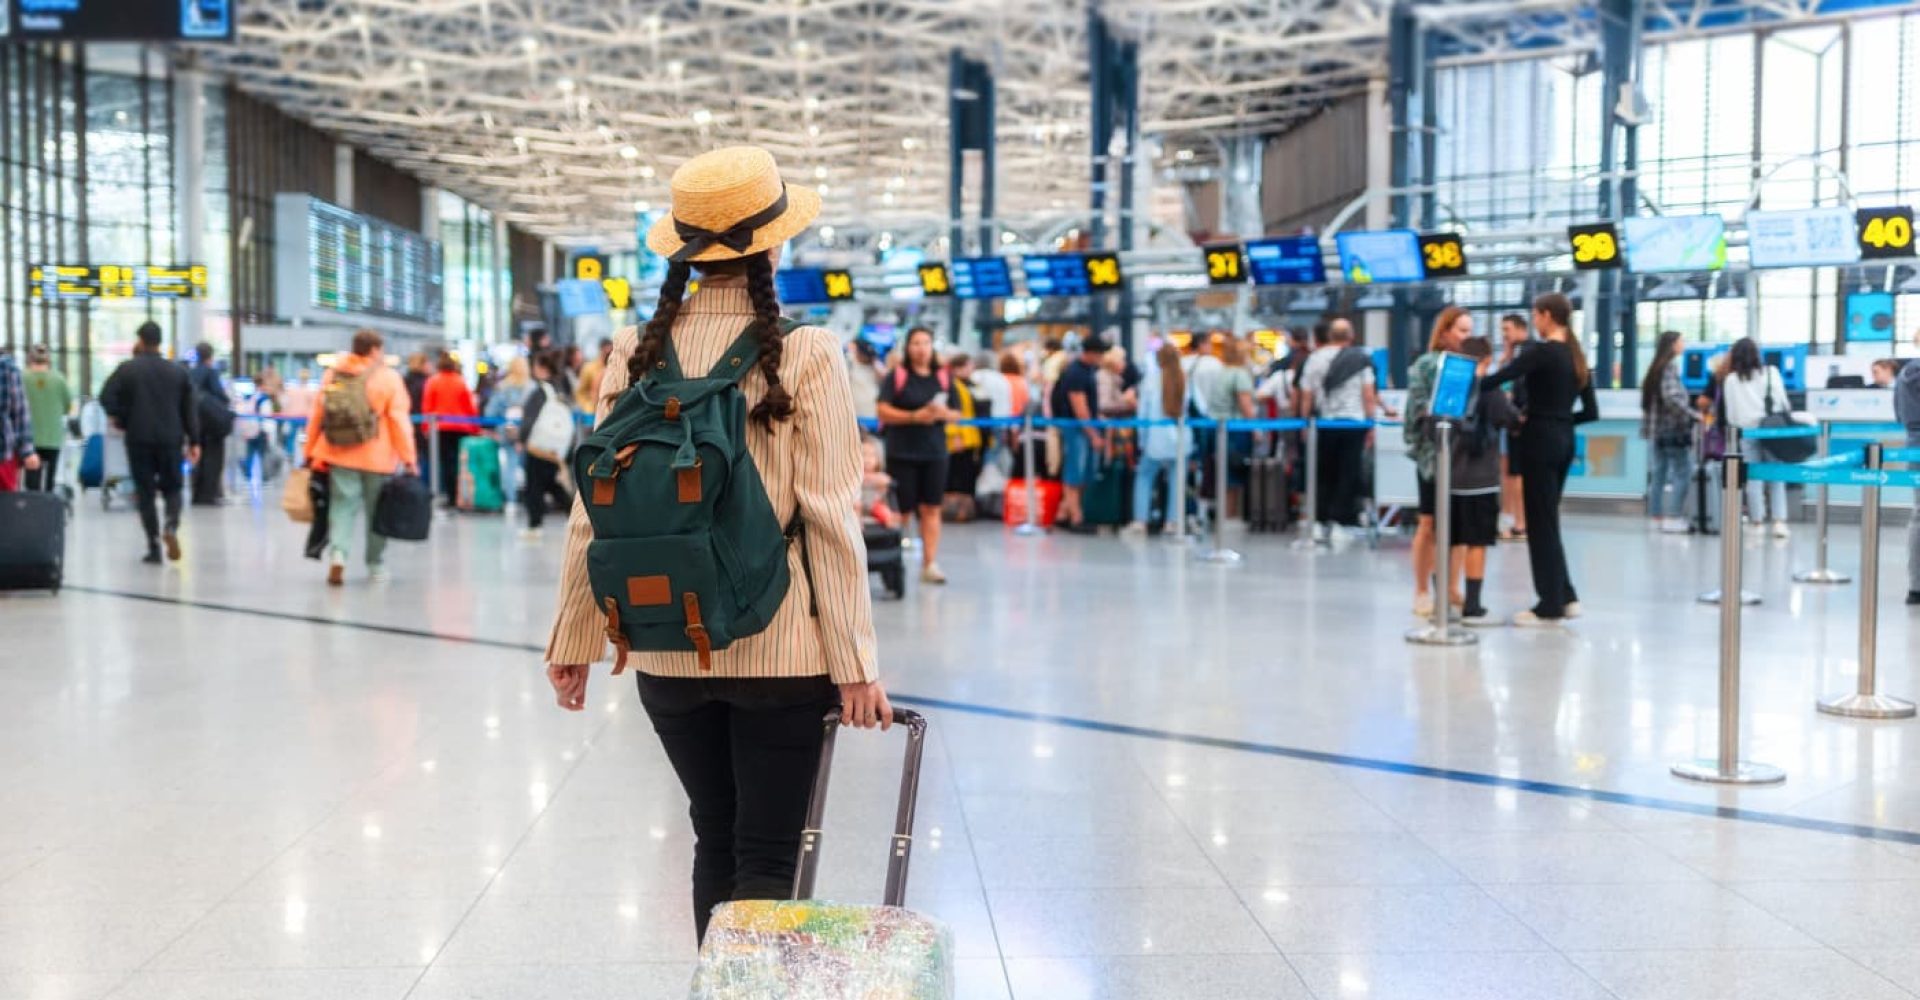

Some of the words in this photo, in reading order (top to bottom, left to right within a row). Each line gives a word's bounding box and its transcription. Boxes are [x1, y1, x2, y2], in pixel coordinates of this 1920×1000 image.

[1862, 215, 1912, 248] 40
[1424, 242, 1462, 269] 38
[1573, 232, 1616, 262] 39
[1207, 252, 1238, 278] 37
